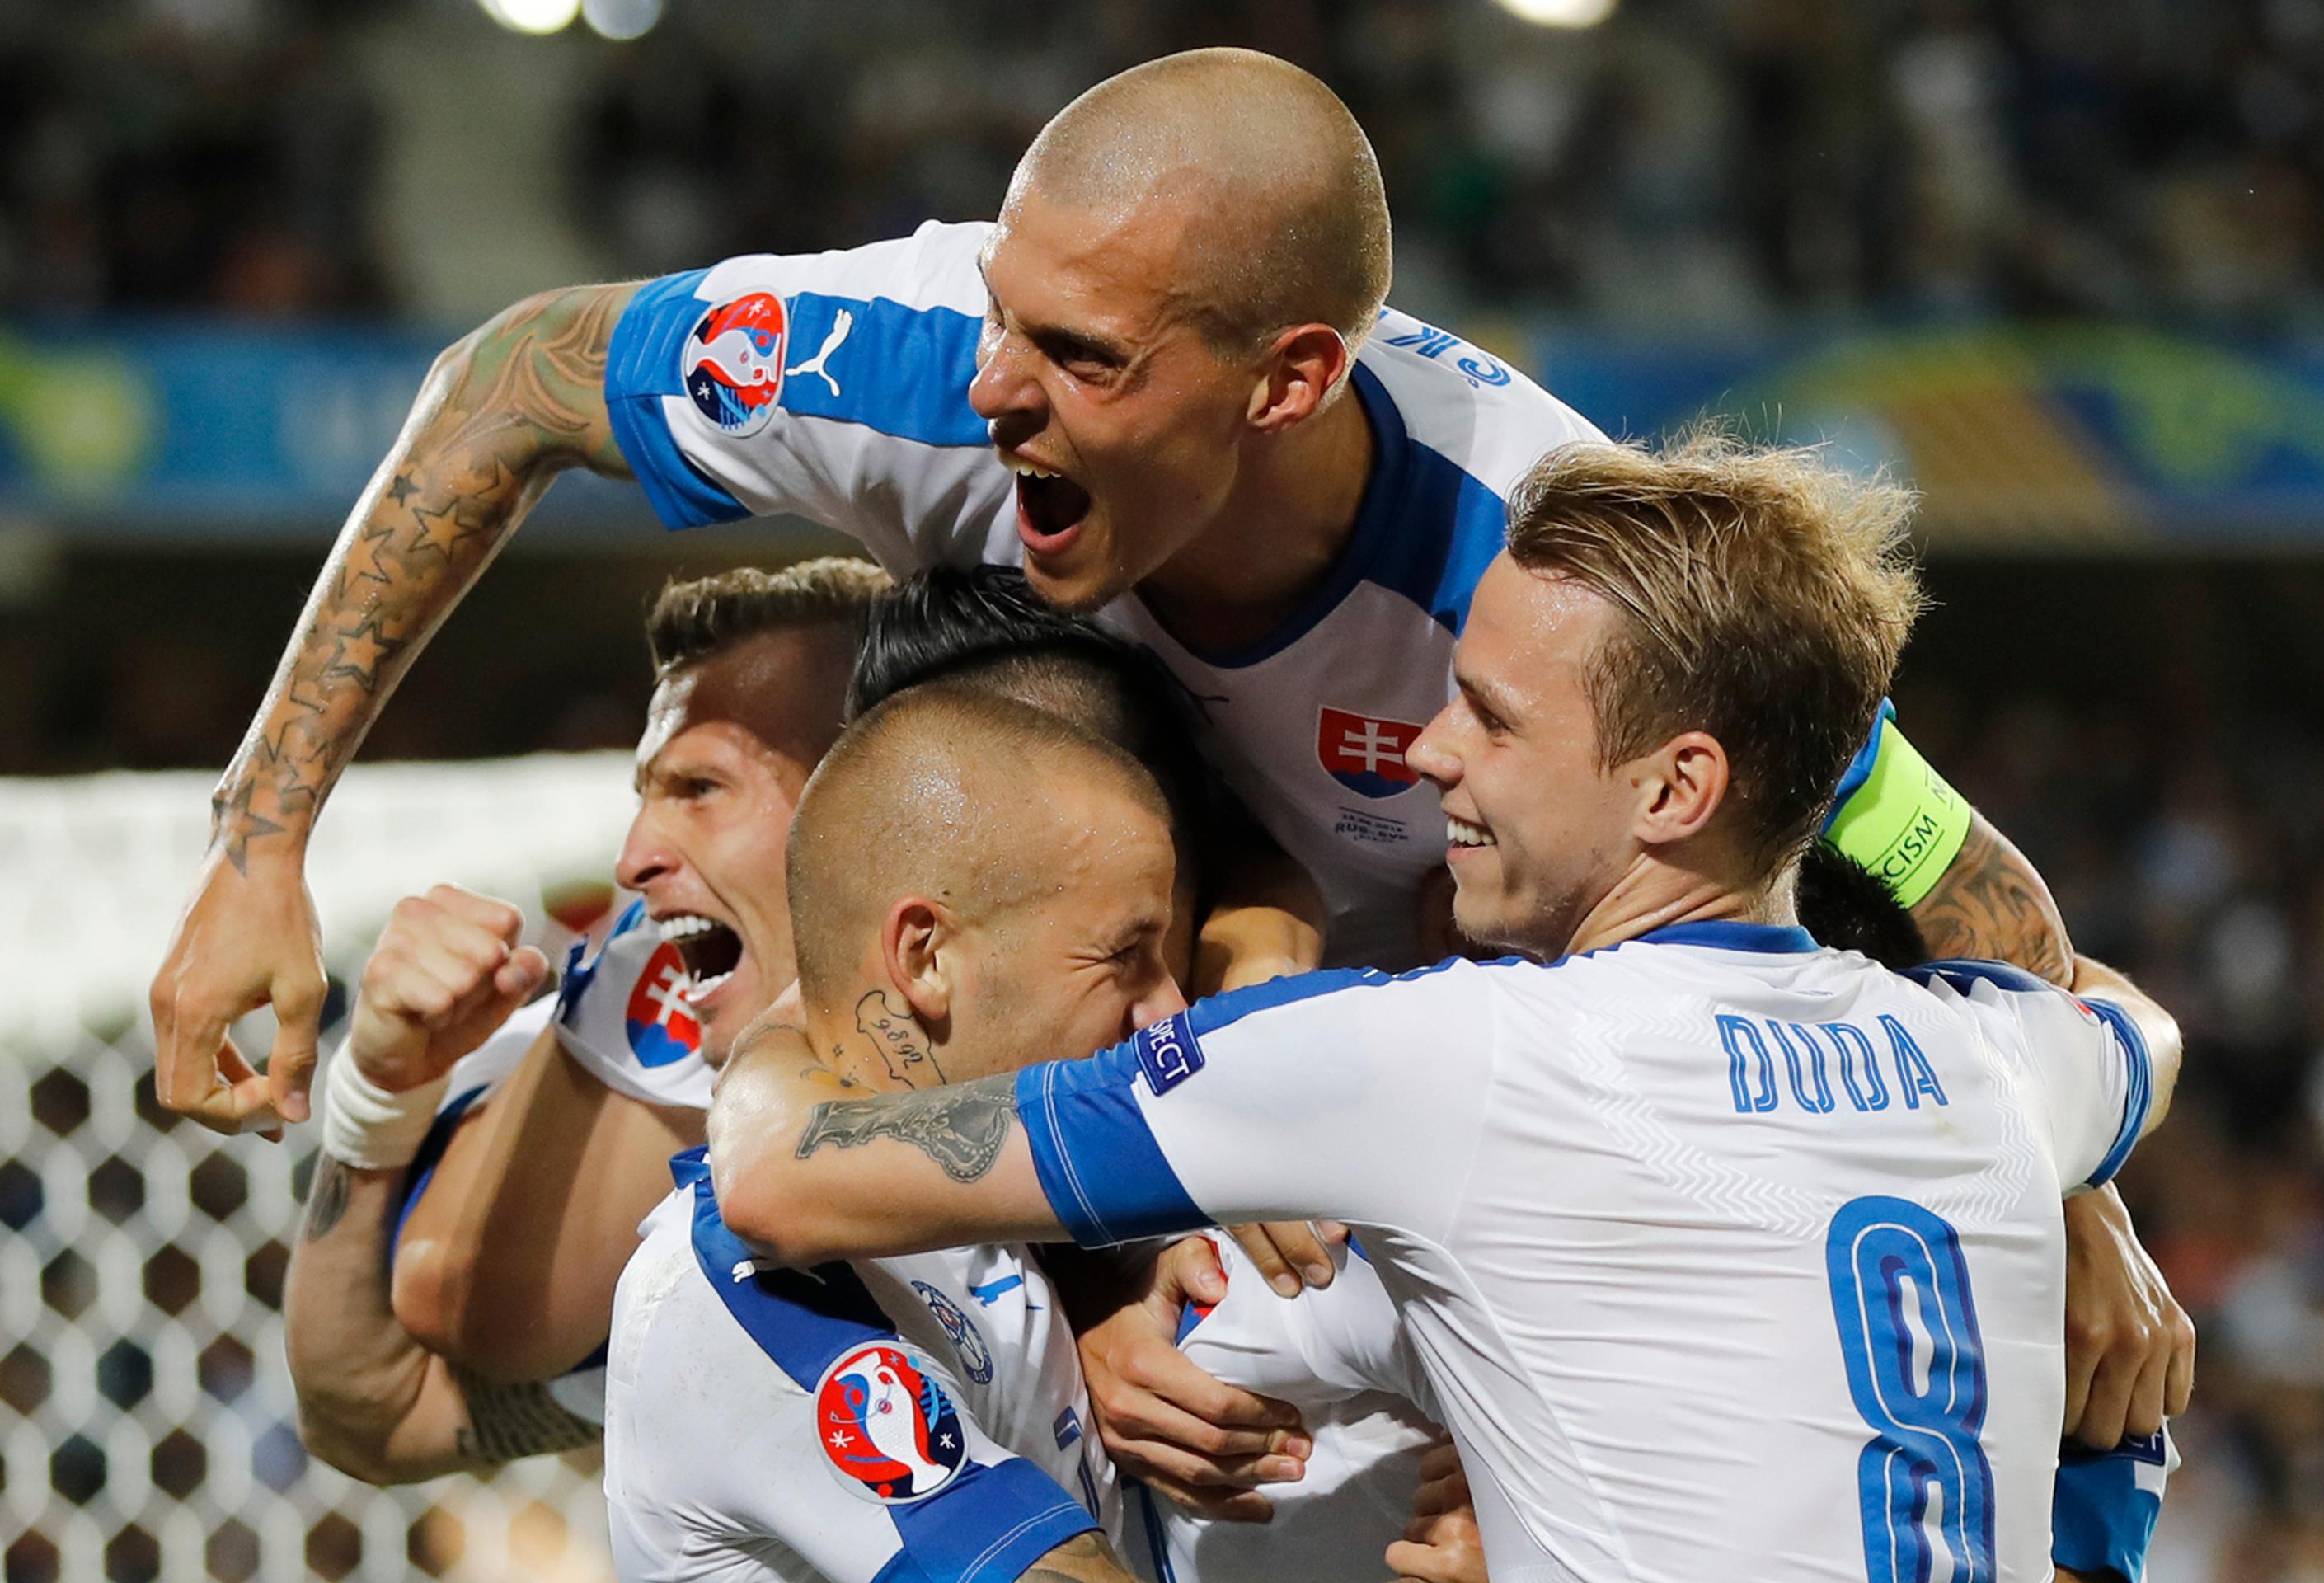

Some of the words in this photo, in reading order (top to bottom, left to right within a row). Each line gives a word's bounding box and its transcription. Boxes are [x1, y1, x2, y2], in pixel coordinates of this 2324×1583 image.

[1883, 814, 1938, 879] CISM
[1148, 1017, 1190, 1080] SPECT
[1715, 1013, 1948, 1113] DUDA
[1825, 1195, 1997, 1583] 8
